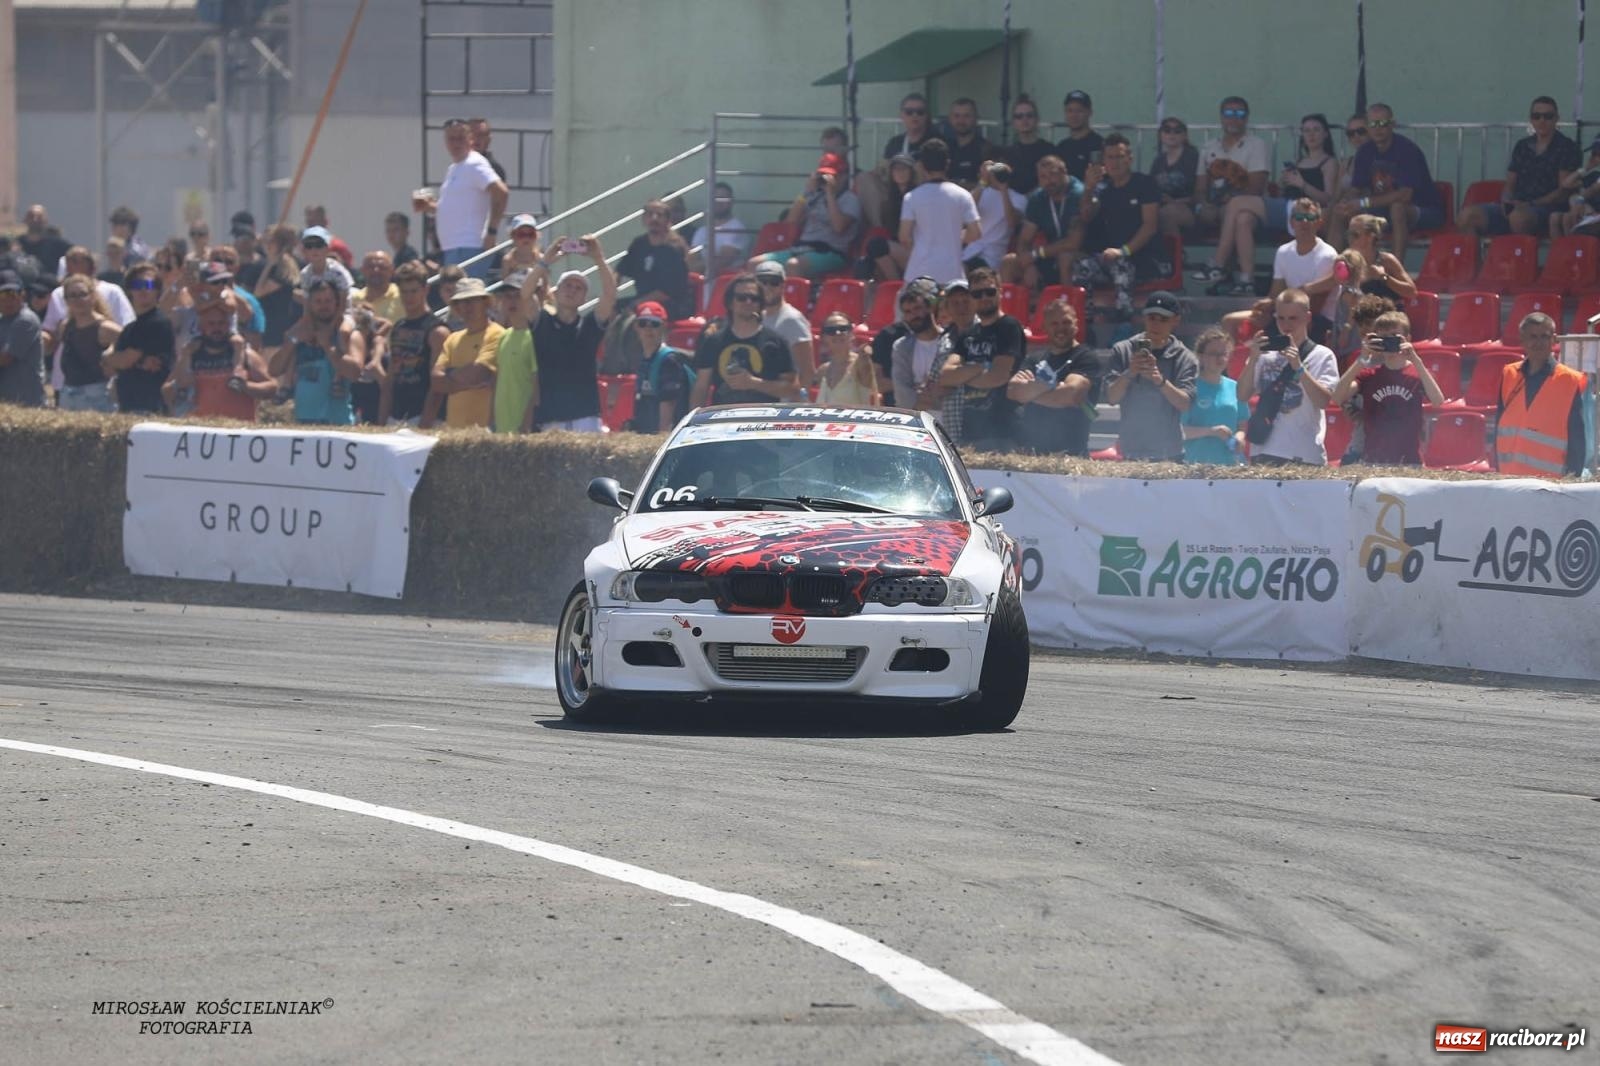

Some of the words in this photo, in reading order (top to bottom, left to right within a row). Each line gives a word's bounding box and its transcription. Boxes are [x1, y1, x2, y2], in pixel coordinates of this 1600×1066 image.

[1372, 385, 1413, 402] ORIGINALS
[174, 431, 267, 463] AUTO
[290, 438, 358, 470] FUS
[650, 485, 698, 509] 06
[200, 502, 322, 538] GROUP
[1150, 540, 1339, 601] AGROEKO
[769, 620, 806, 634] RV
